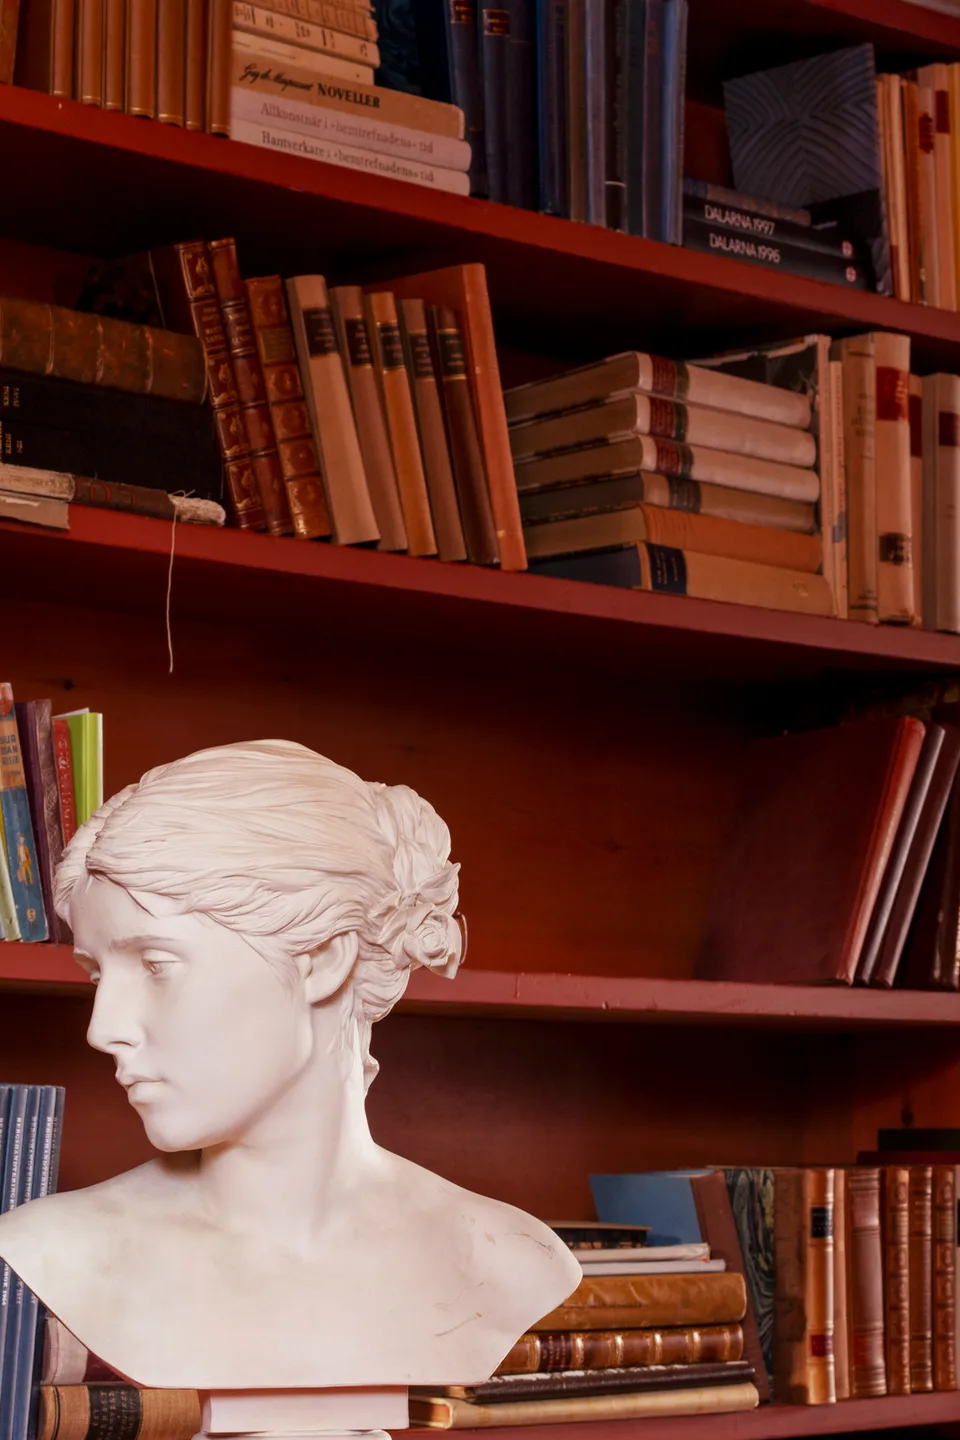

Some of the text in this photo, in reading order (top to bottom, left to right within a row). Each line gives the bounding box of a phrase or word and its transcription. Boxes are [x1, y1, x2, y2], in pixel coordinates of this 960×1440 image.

[317, 83, 381, 108] NOVELLER
[260, 102, 322, 129] Allkonstnär
[419, 141, 434, 154] tid
[261, 130, 324, 159] Hantverkare
[420, 168, 435, 183] tid
[704, 204, 775, 236] DALARNA 1997
[709, 233, 780, 264] DALARNA 1996
